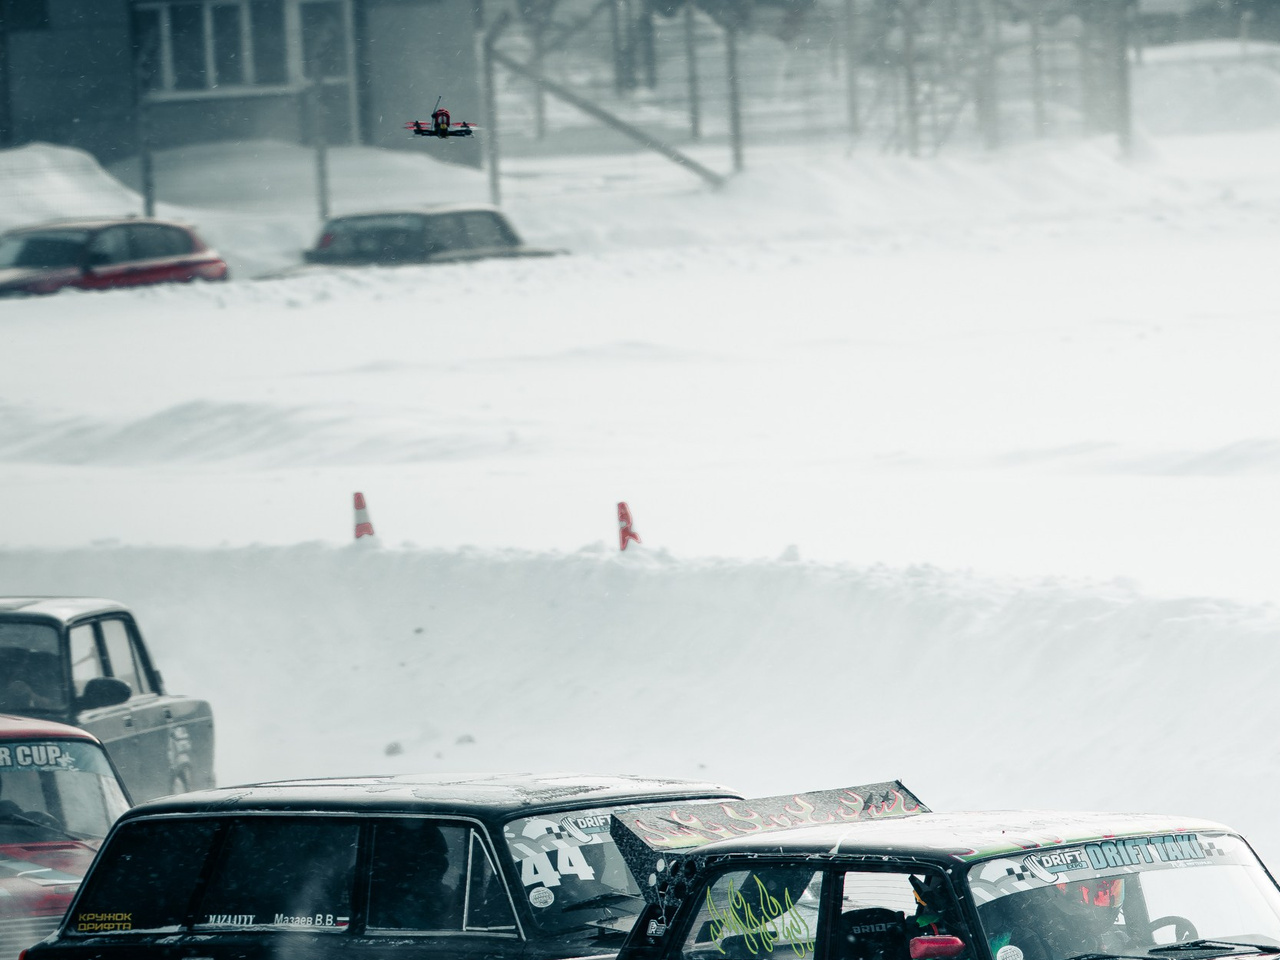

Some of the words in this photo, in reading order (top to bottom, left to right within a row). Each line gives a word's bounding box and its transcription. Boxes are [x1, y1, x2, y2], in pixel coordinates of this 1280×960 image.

[17, 745, 61, 765] CUP
[1042, 850, 1082, 868] DRIFT
[1085, 838, 1154, 870] DRIFT
[1150, 834, 1205, 862] TAXI
[521, 846, 595, 888] 44
[77, 922, 132, 931] ДРИФТА
[78, 913, 132, 922] КРУЖОК
[274, 913, 313, 926] Мазаев
[315, 914, 336, 926] В.В.
